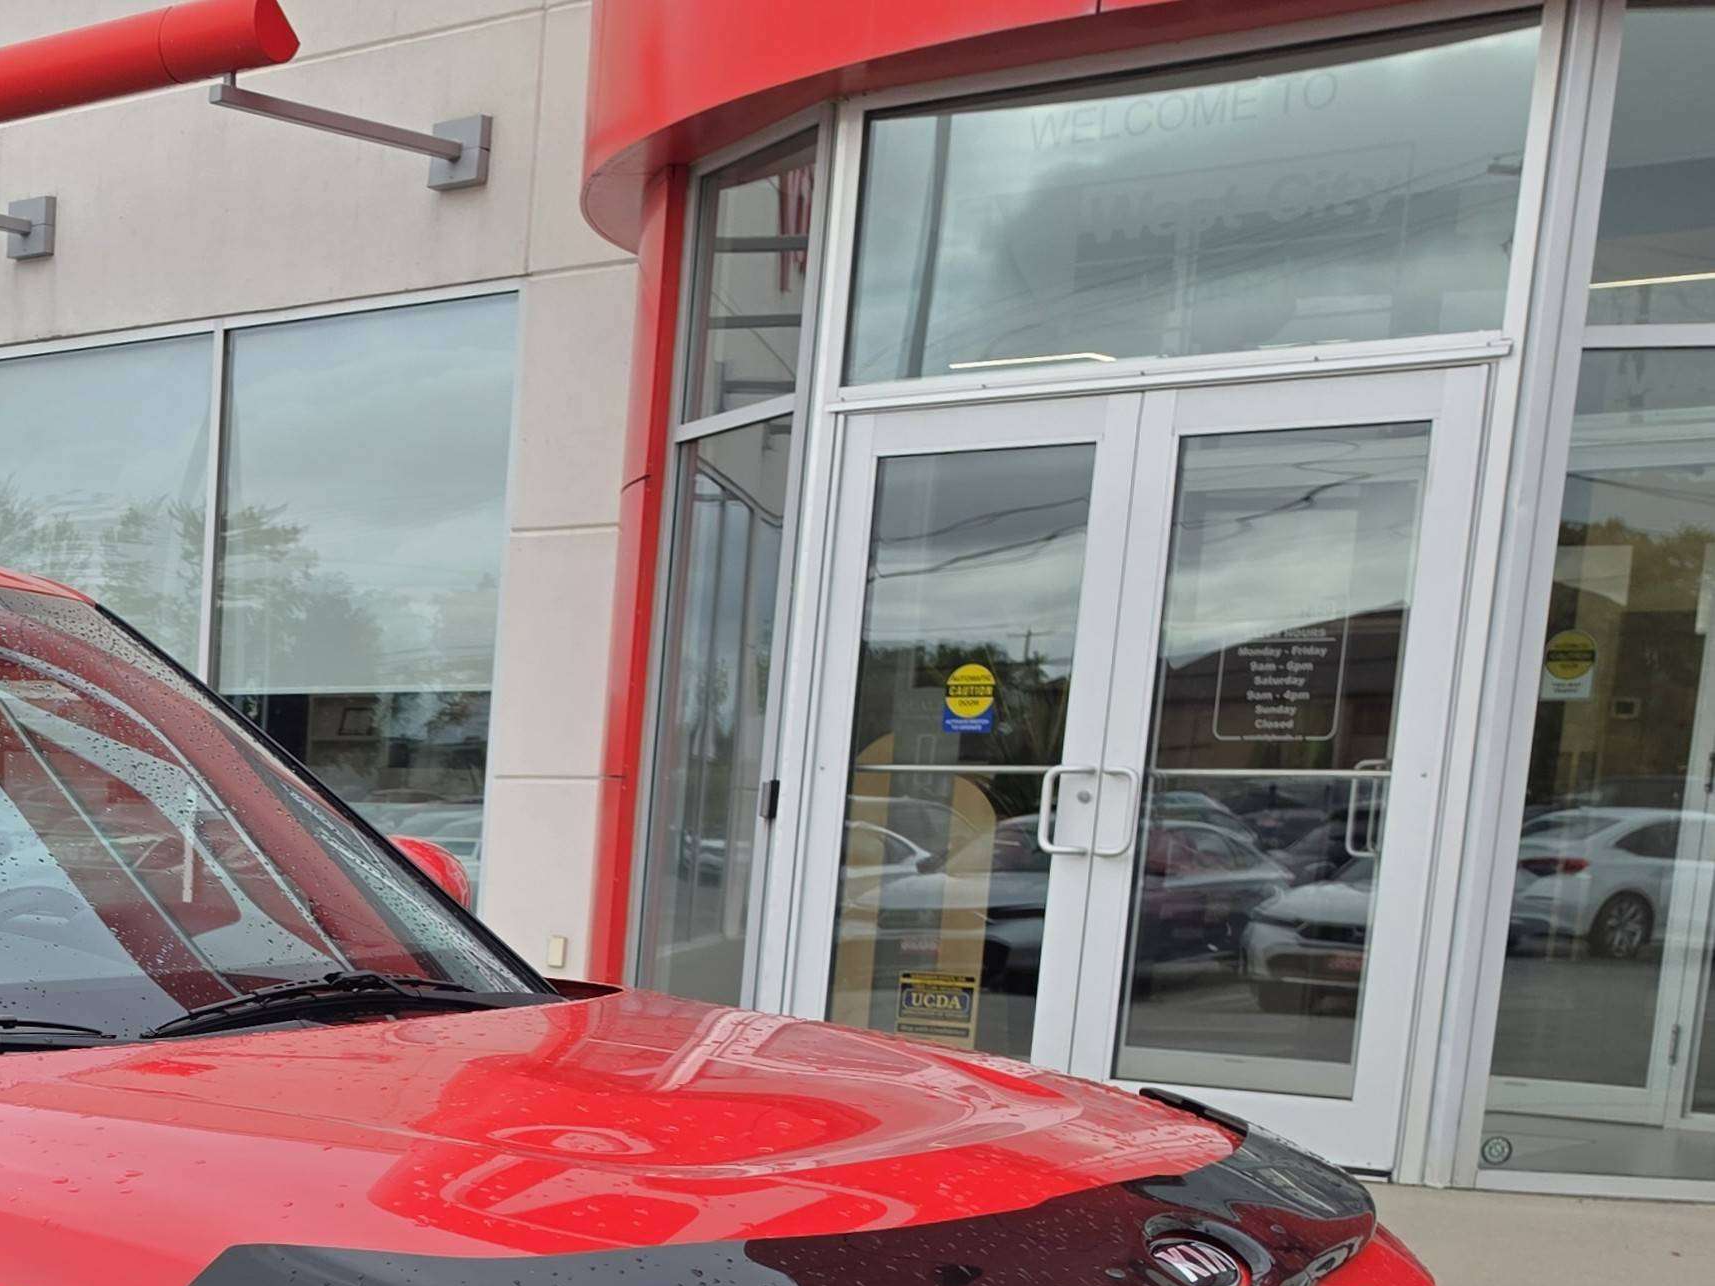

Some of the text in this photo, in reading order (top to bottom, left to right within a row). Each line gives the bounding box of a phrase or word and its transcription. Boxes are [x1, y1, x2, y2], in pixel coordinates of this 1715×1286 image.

[1030, 72, 1338, 150] WELCOME TO
[1237, 646, 1282, 659] Monday
[1291, 645, 1328, 658] Friday
[1249, 661, 1277, 672] 9am
[1253, 676, 1306, 687] Saturday
[948, 685, 994, 696] CAUTION
[1254, 704, 1297, 716] Sunday
[1254, 720, 1295, 729] Closed
[911, 993, 962, 1009] UCDA
